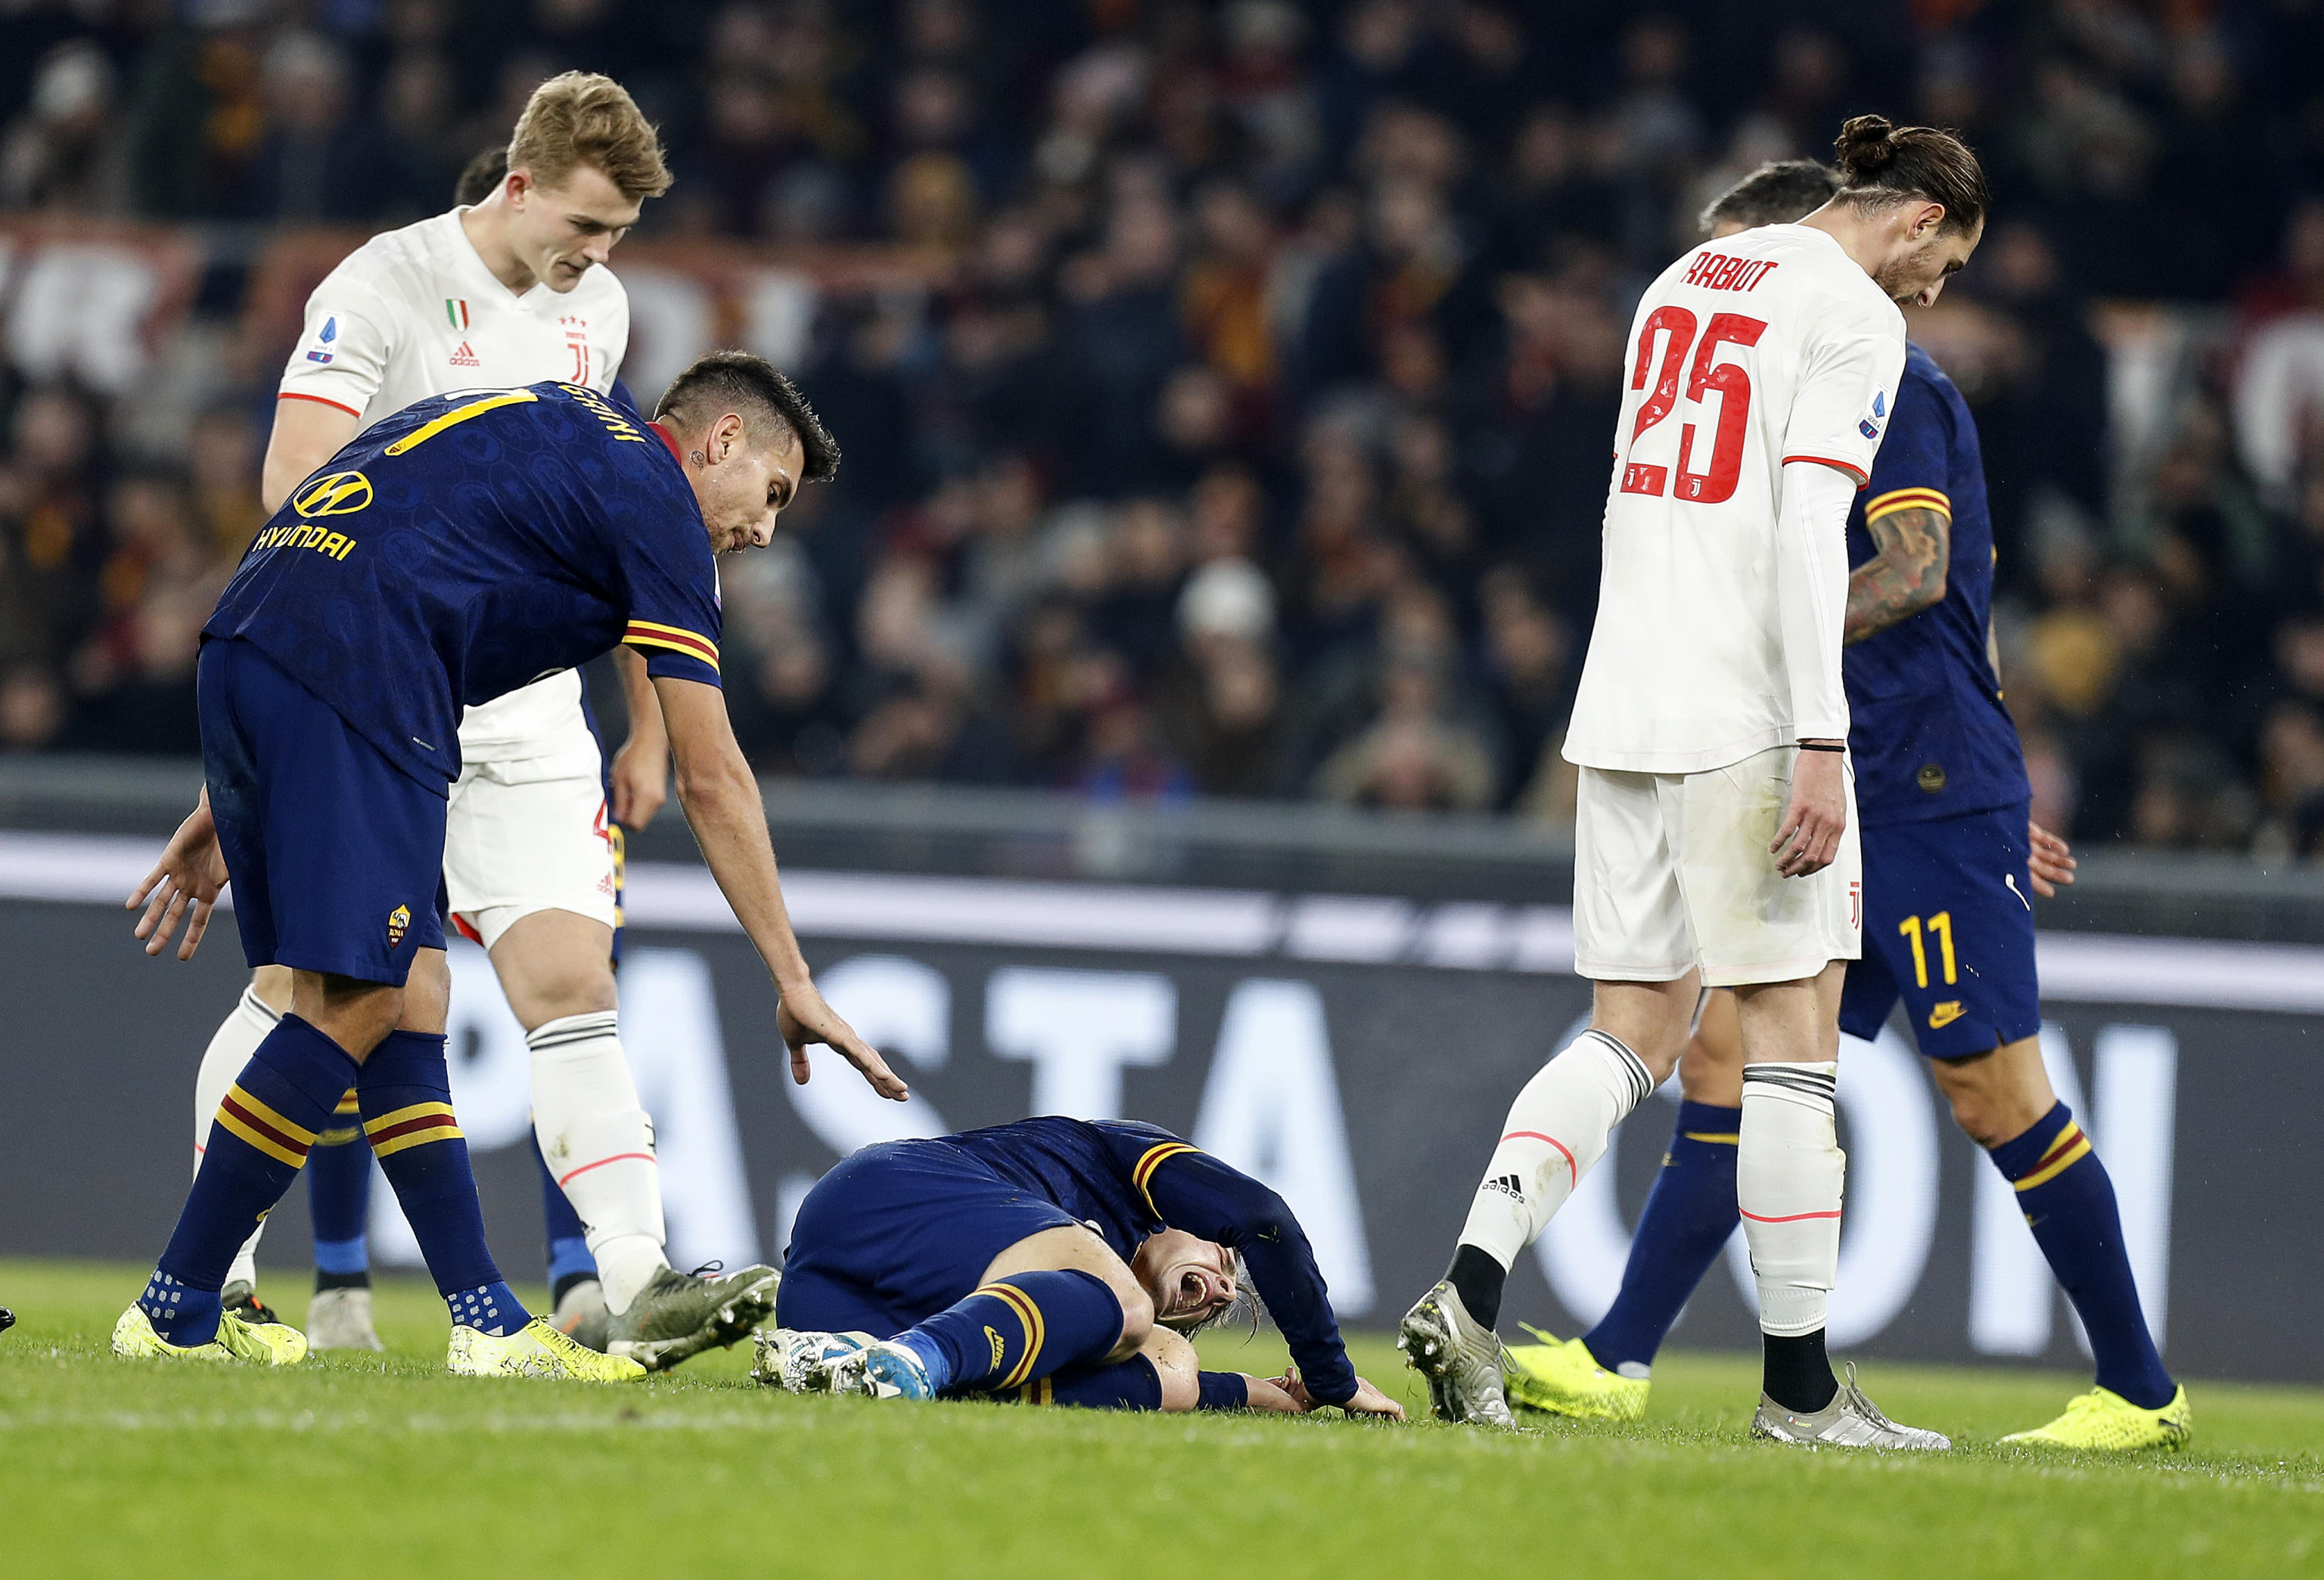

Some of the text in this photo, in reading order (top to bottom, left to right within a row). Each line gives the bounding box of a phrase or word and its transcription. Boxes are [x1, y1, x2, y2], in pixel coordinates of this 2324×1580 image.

[1679, 252, 1779, 292] RABIOT
[558, 383, 646, 443] GRINI
[1620, 305, 1769, 504] 25
[251, 524, 357, 561] HYUNDAI
[1899, 911, 1958, 989] 11
[369, 934, 1378, 1318] PASTA
[1481, 1183, 1527, 1204] adidas
[993, 1333, 1005, 1370] NIKE
